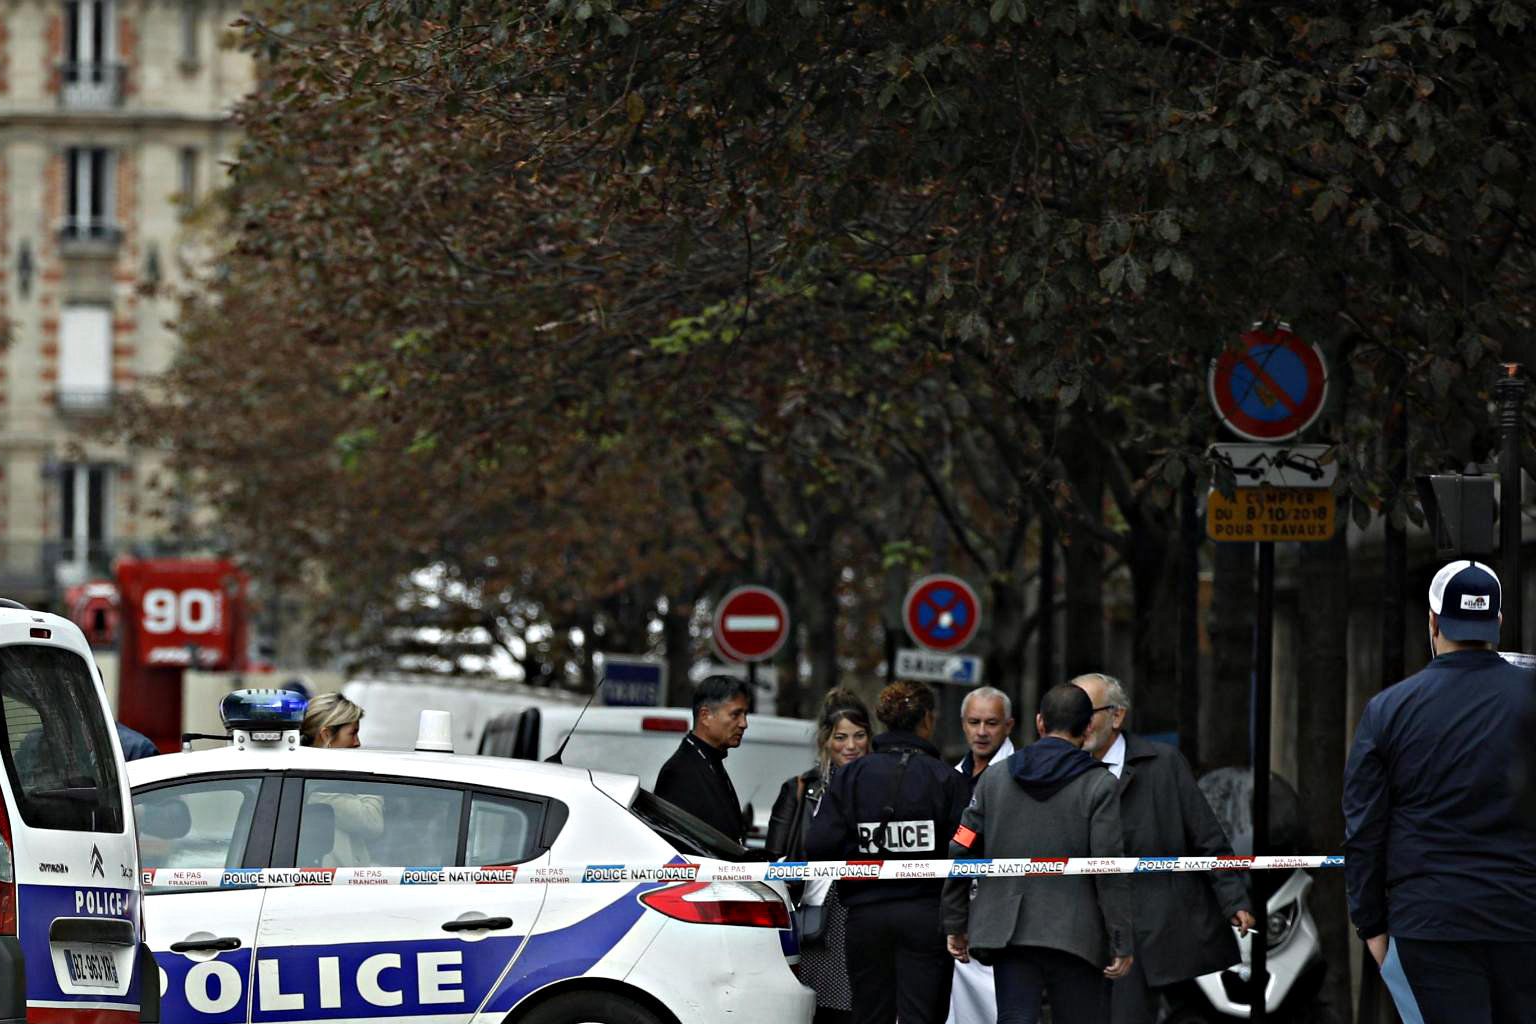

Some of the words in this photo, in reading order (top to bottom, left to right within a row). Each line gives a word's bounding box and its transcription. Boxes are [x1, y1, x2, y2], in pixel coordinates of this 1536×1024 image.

[1215, 523, 1254, 536] POUR
[1262, 523, 1327, 536] TRAVAUX
[142, 588, 214, 634] 90
[952, 864, 994, 874] POLICE
[998, 863, 1063, 873] NATIONALE
[1138, 861, 1180, 869] POLICE
[1184, 859, 1251, 868] NATIONALE
[404, 871, 445, 882] POLICE
[449, 870, 513, 882] NATIONALE
[586, 869, 628, 880] POLICE
[631, 868, 695, 879] NATIONALE
[769, 867, 810, 878] POLICE
[813, 865, 878, 877] NATIONALE
[224, 873, 264, 884] POLICE
[268, 872, 332, 884] NATIONALE
[75, 890, 123, 915] POLICE
